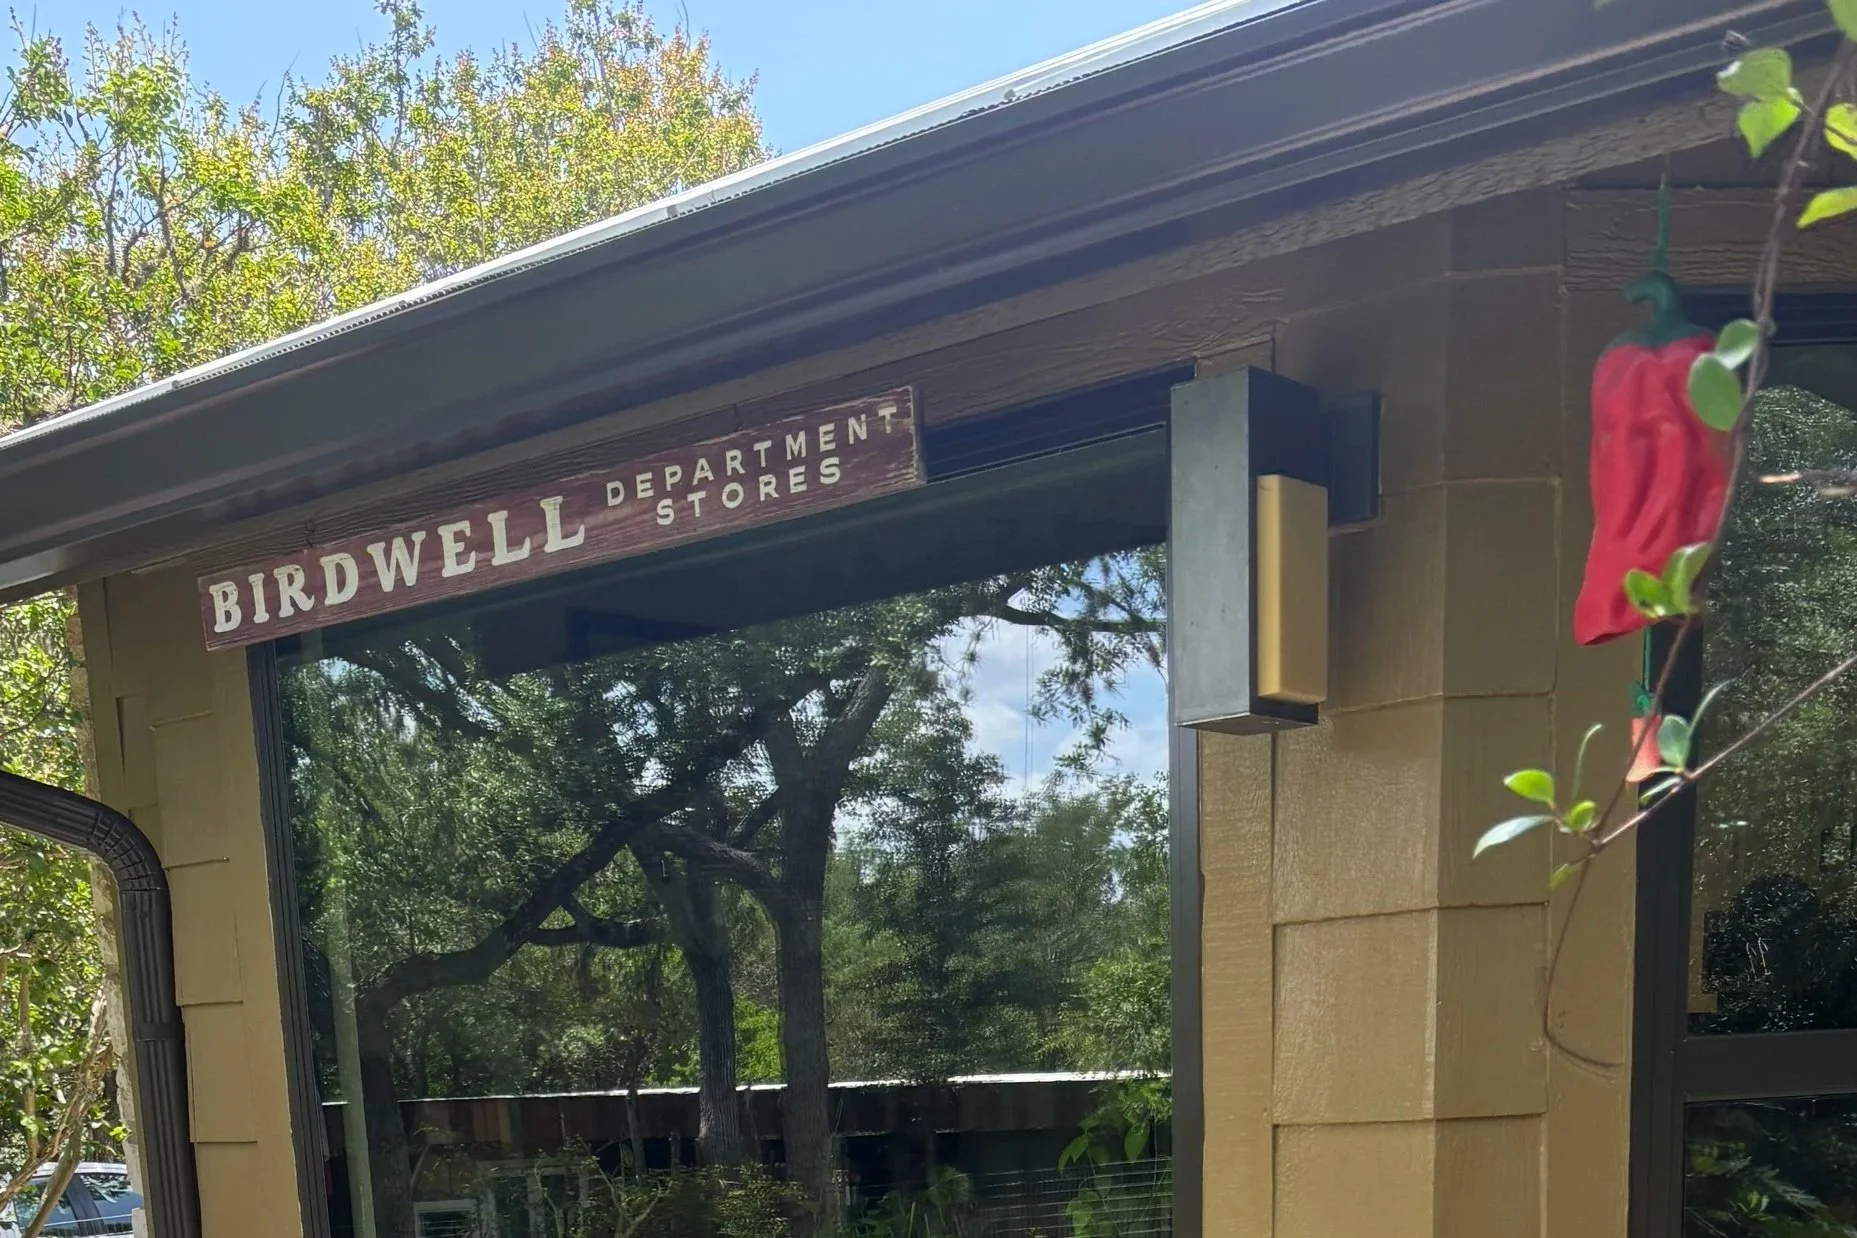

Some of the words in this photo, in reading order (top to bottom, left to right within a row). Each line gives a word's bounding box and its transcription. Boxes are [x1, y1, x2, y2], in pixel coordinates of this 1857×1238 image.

[606, 406, 897, 506] DEPARTMENT
[656, 457, 841, 525] STORES
[209, 495, 585, 633] BIRDWELL
